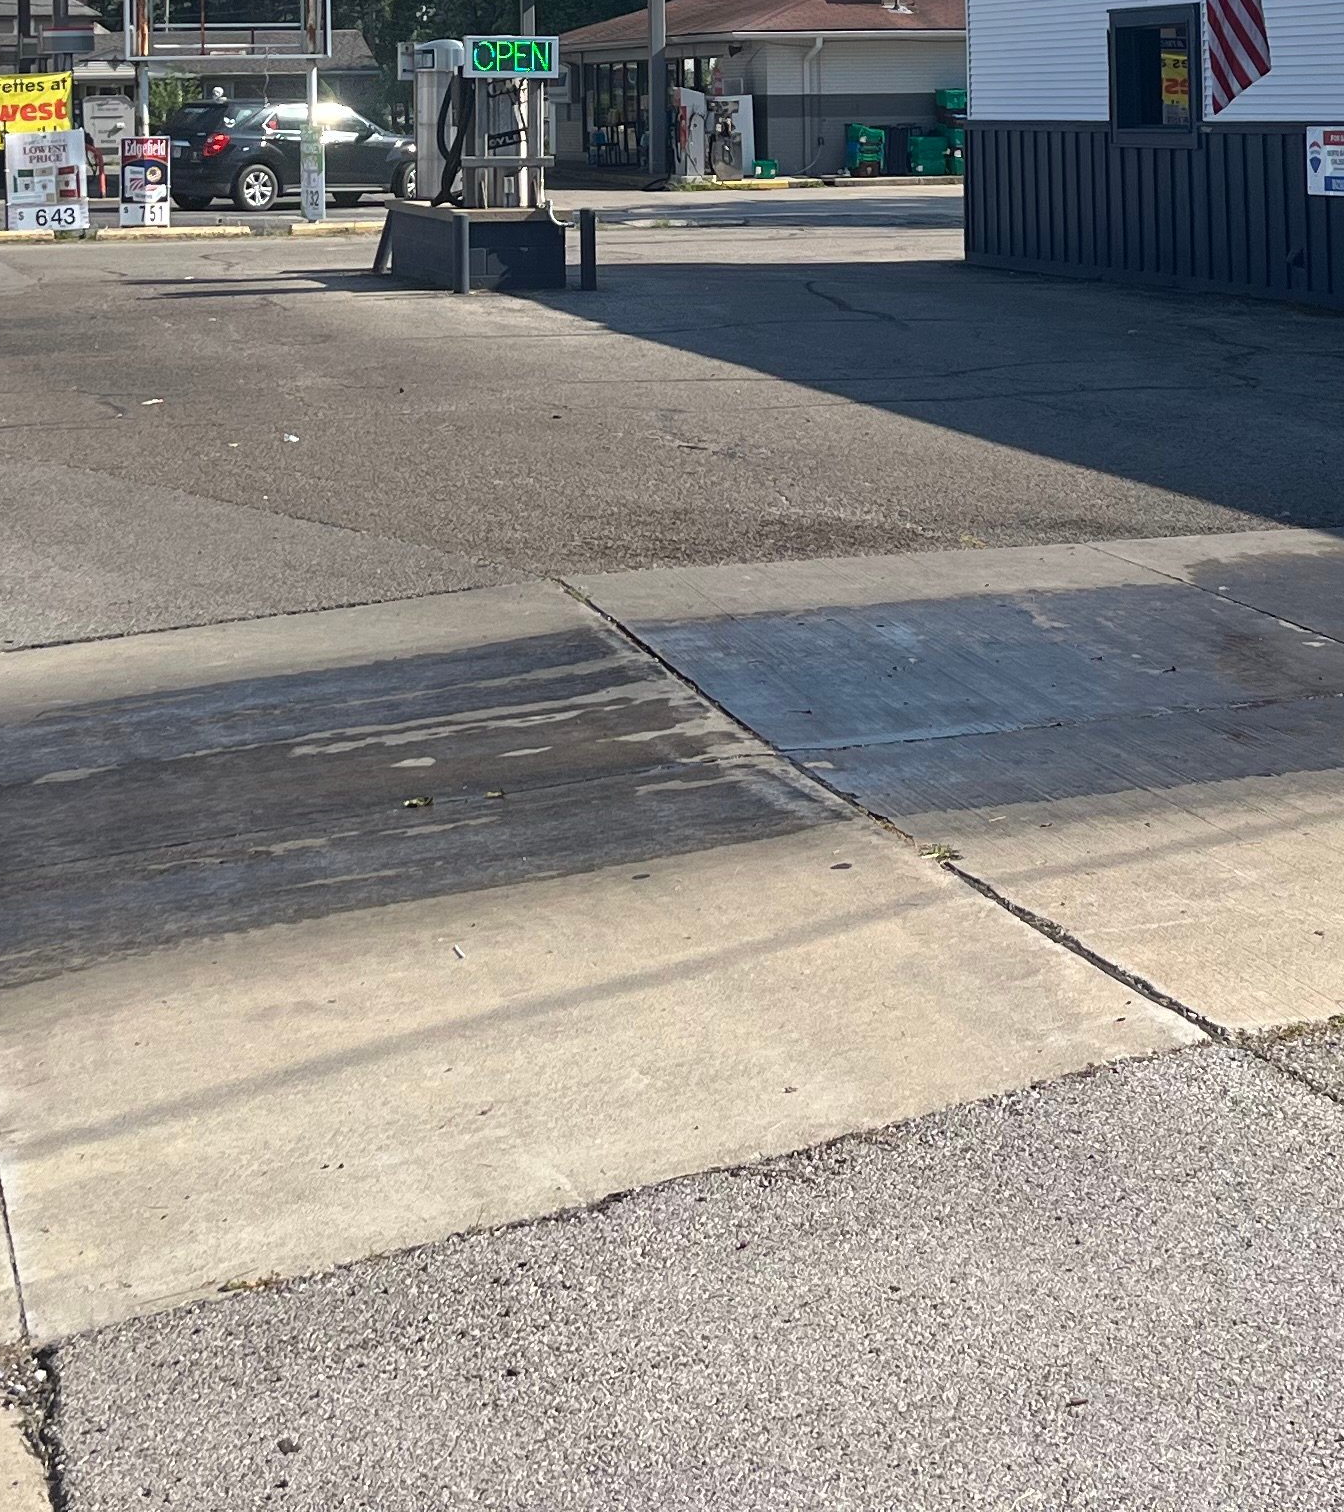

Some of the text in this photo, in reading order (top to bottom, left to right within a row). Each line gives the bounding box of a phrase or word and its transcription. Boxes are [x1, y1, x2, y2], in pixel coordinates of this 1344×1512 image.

[474, 41, 548, 71] OPEN
[50, 77, 67, 90] at
[23, 144, 67, 155] LOWEST
[124, 140, 166, 158] Edgefield
[29, 154, 63, 163] PRICE
